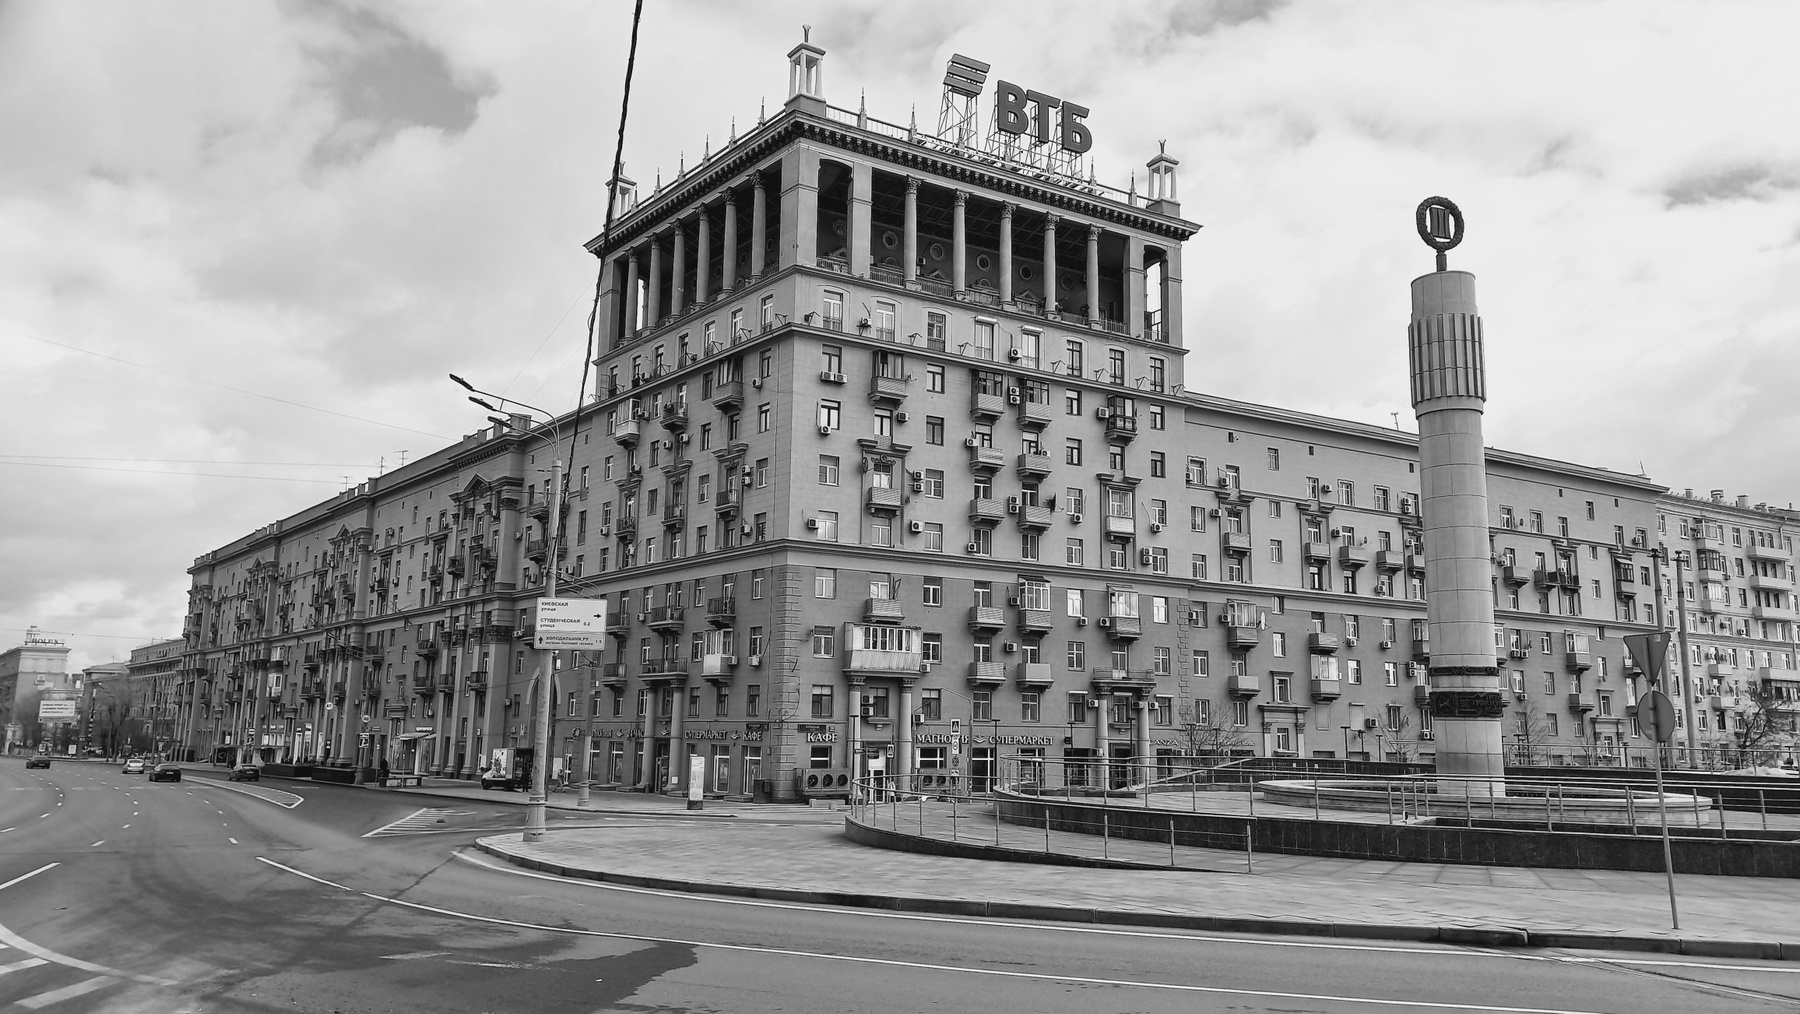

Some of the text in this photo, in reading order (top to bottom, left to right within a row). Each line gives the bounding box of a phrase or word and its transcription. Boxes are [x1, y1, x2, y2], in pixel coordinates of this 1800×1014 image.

[997, 79, 1092, 153] ВТБ
[684, 730, 762, 741] СУПЕРМАРКЕТ КАФЕ
[807, 733, 839, 742] КАФЕ
[916, 734, 1054, 745] МАГНОИЯ СУПЕРМАРКЕТ
